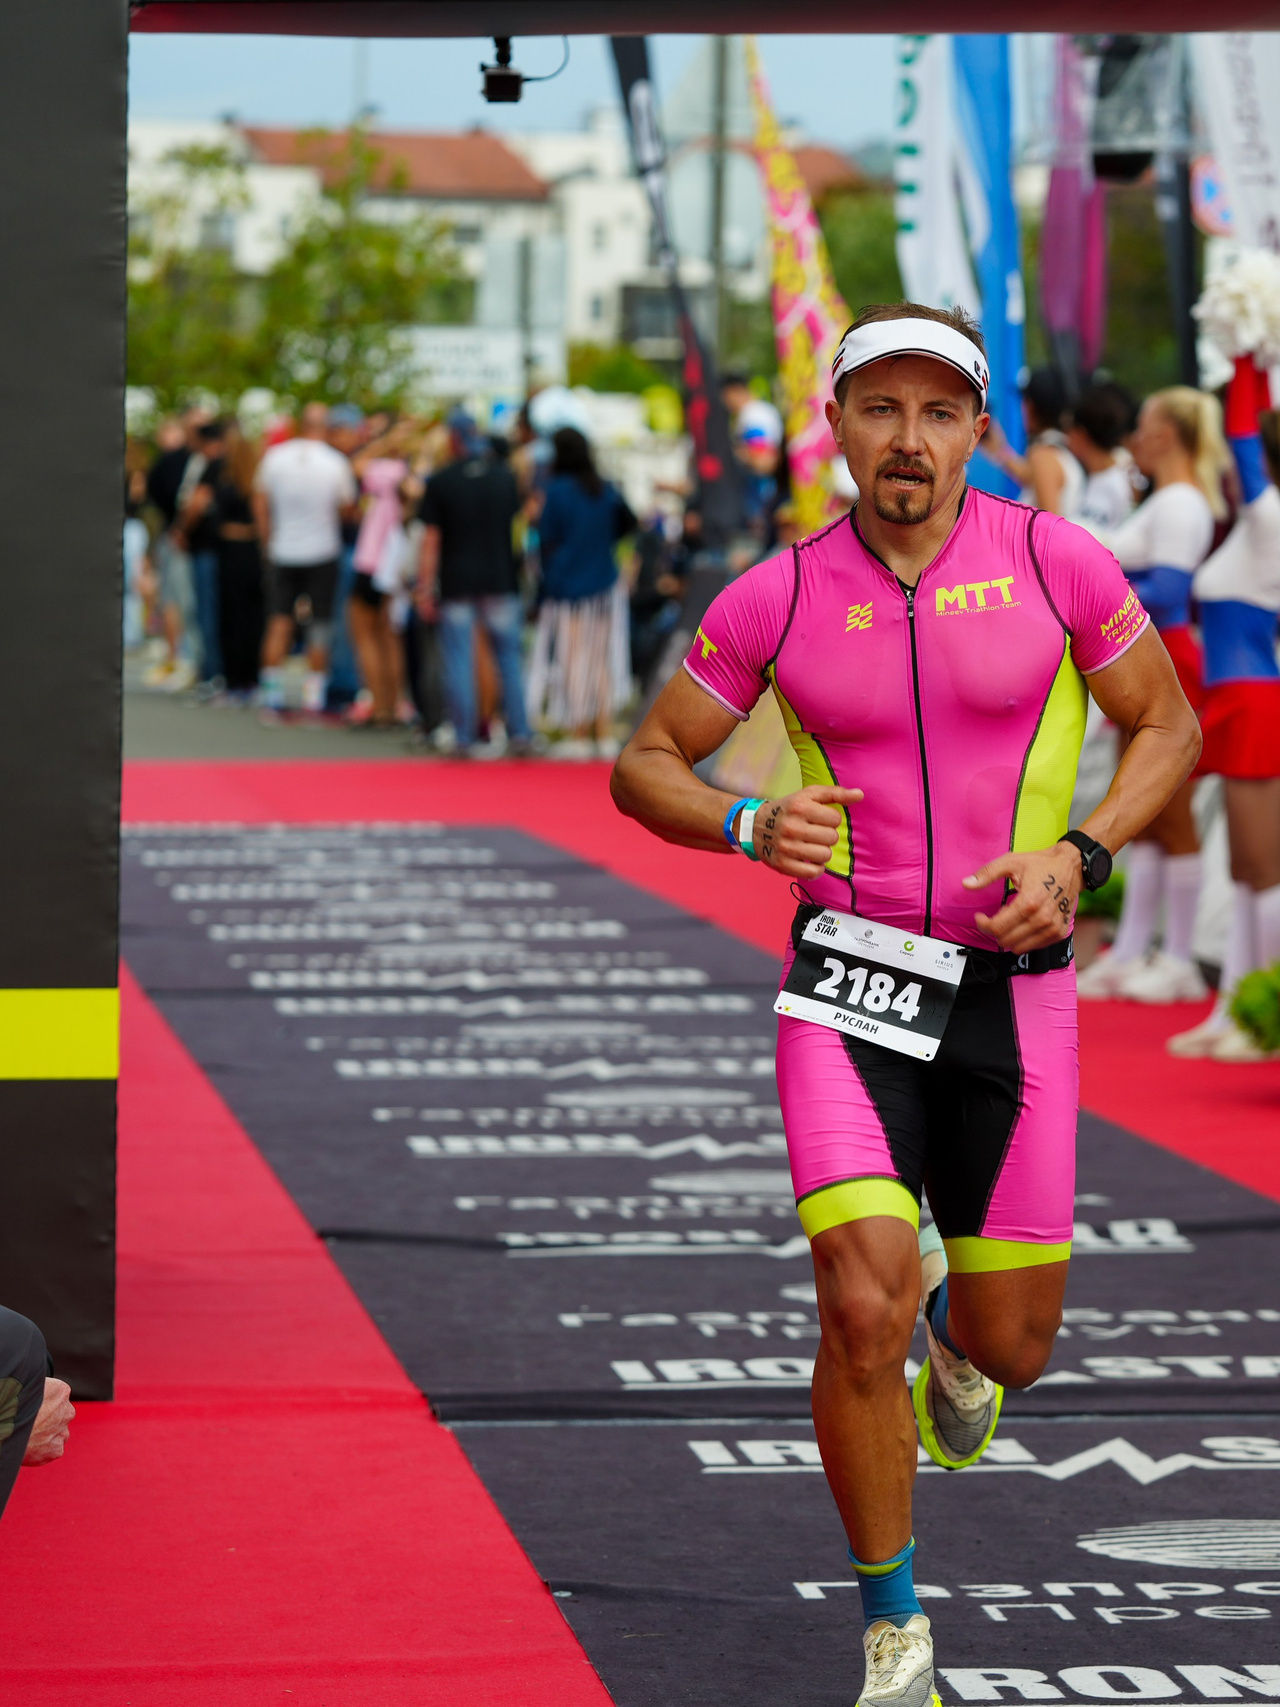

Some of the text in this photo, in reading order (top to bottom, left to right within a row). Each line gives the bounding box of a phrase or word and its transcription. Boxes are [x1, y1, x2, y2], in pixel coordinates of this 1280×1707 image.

[935, 575, 1014, 612] MTT
[936, 601, 1022, 617] Mineev Triathlon Team
[815, 922, 838, 937] STAR
[819, 914, 836, 926] IRON
[934, 959, 954, 969] SIRIUS
[813, 957, 923, 1023] 2184
[833, 1012, 880, 1035] РУСЛАН
[610, 1357, 922, 1383] IRO
